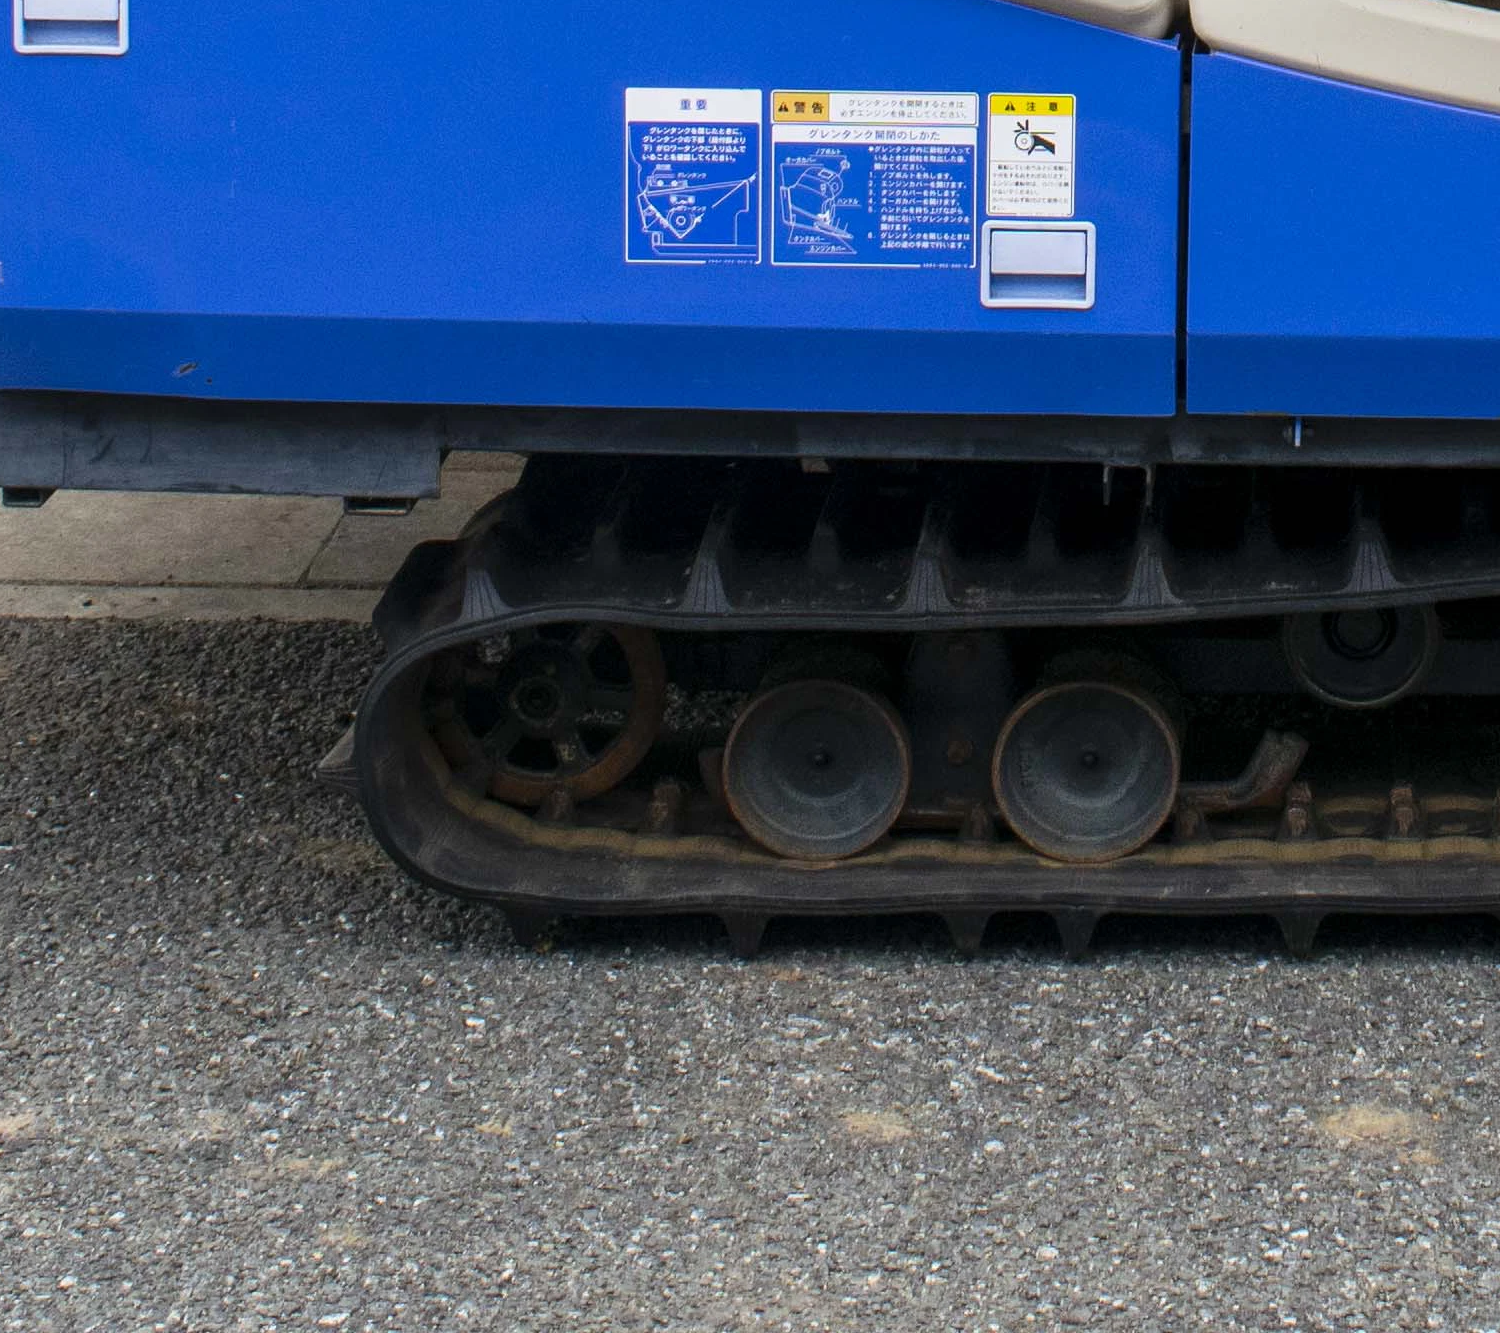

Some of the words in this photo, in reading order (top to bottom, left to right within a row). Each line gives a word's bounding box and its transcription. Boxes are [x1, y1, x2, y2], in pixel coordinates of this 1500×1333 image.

[680, 98, 707, 111] 重要
[793, 101, 825, 114] 警告
[1026, 101, 1059, 112] 注意
[808, 128, 941, 141] グレンタンク開閉のしかた
